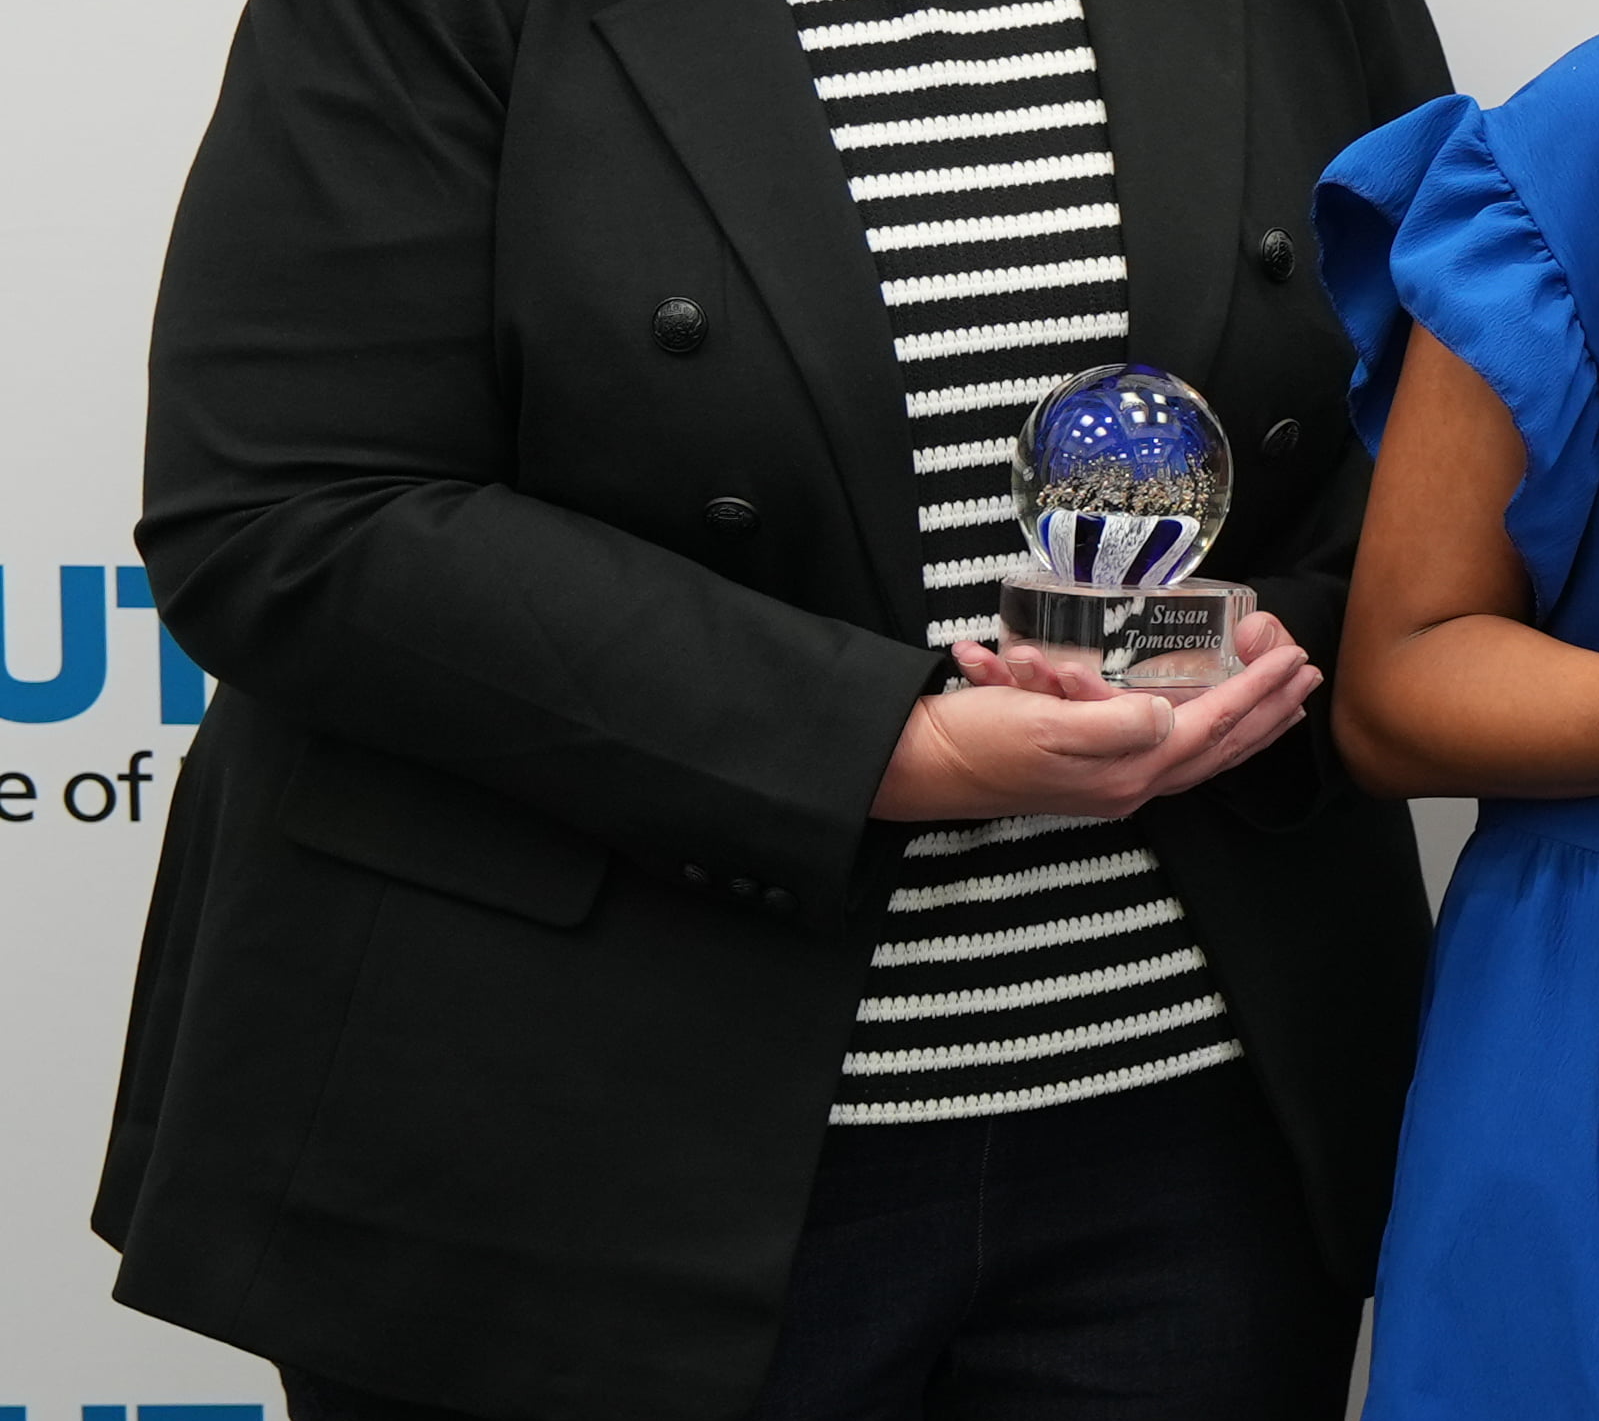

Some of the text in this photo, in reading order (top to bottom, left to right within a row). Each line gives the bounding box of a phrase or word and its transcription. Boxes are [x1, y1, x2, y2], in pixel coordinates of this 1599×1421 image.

[1150, 603, 1209, 625] Susan
[1125, 629, 1224, 651] Tomasevic
[63, 750, 153, 822] of
